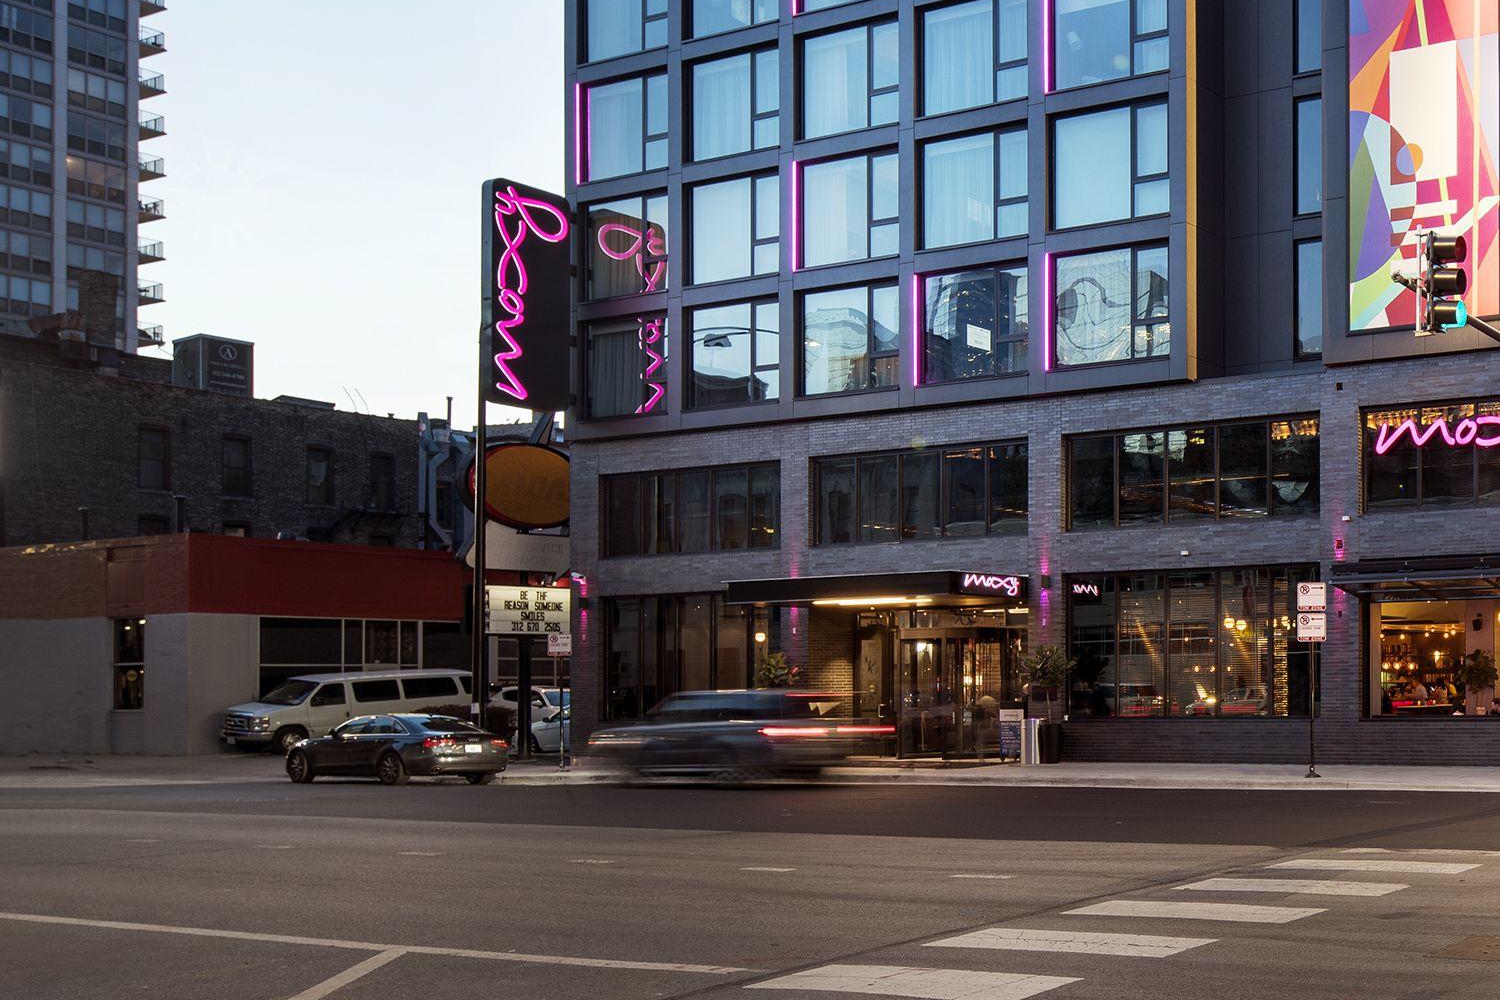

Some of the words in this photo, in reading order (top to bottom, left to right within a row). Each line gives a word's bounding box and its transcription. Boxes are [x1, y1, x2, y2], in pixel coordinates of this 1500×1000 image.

[963, 573, 1021, 596] moxy
[520, 591, 528, 600] BE
[504, 600, 529, 610] REASON
[534, 601, 563, 611] SOMEONE
[520, 611, 545, 621] SMILES
[511, 621, 523, 631] 312
[527, 621, 539, 631] 670
[544, 622, 561, 632] 2505
